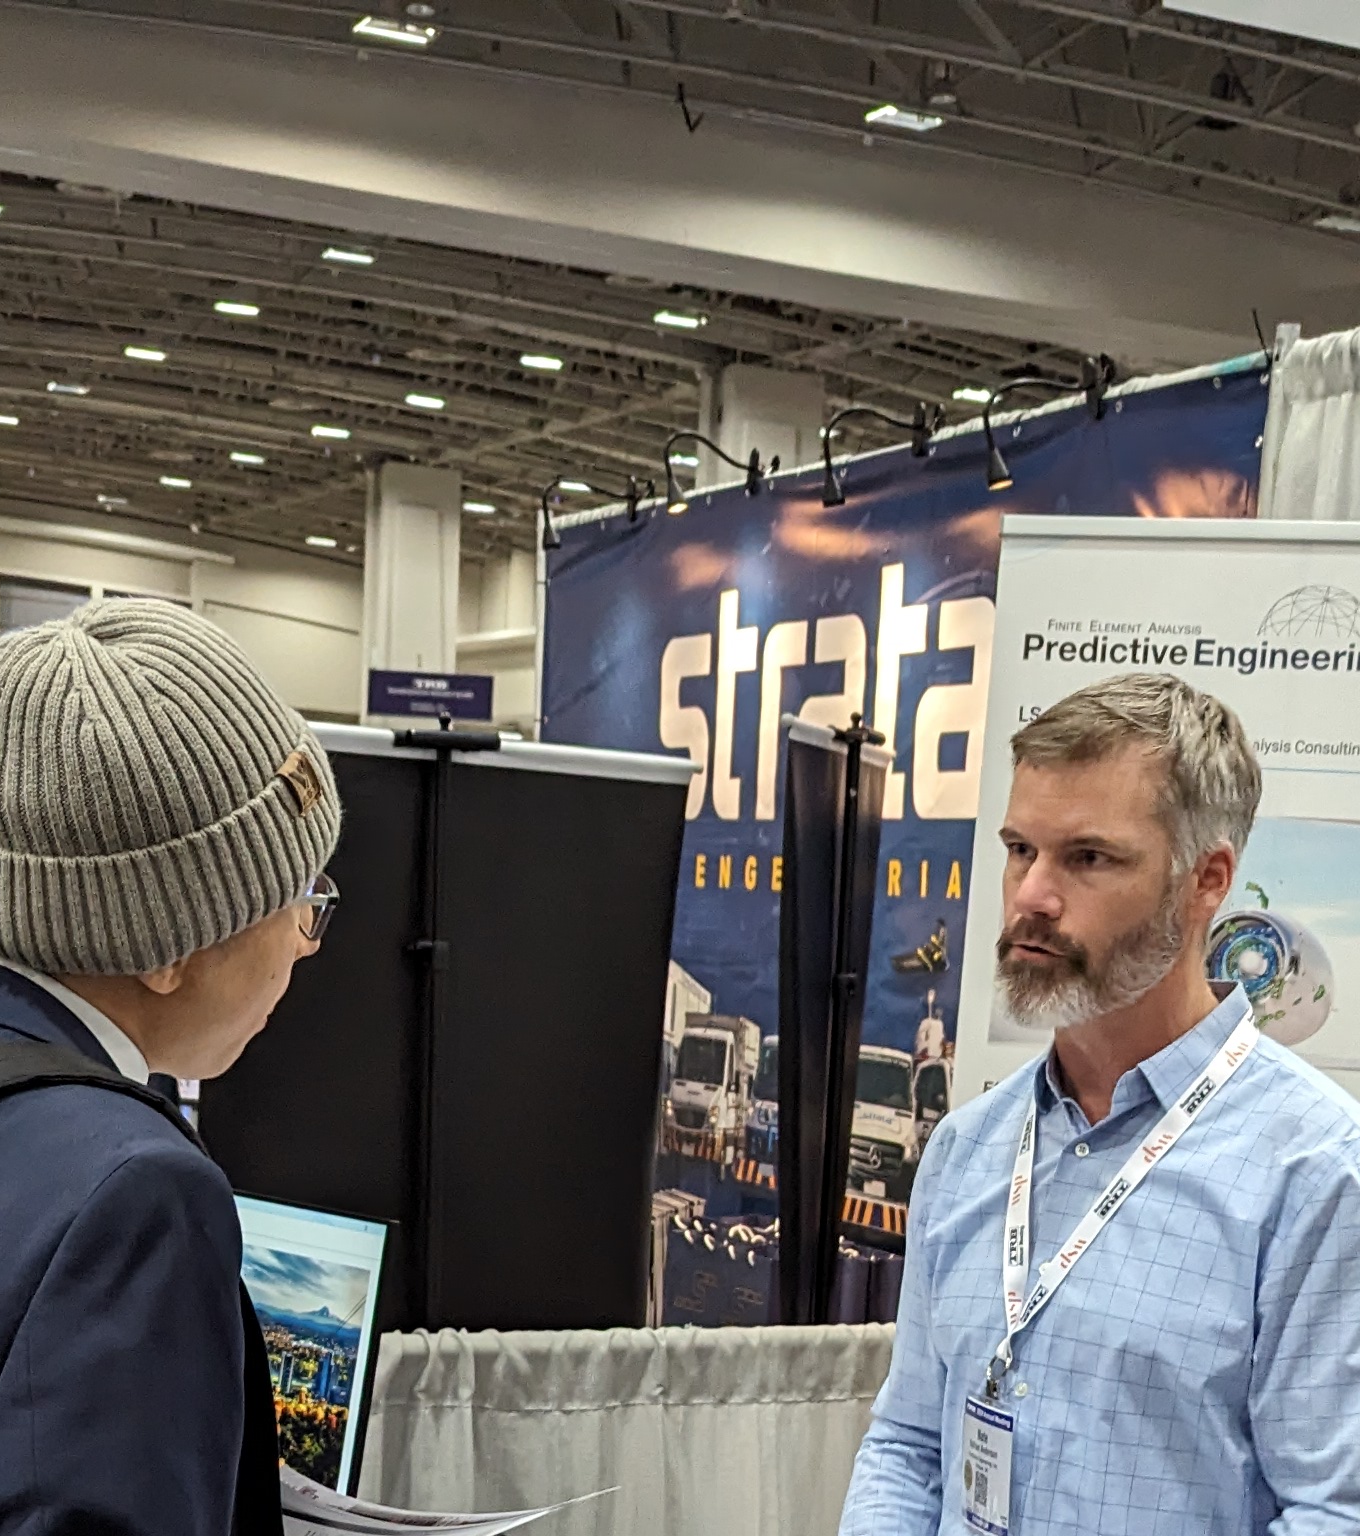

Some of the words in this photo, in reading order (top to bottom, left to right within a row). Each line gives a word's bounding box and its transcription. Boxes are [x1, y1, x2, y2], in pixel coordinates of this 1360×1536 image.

[1048, 618, 1082, 633] FINITE
[1089, 620, 1141, 634] ELEMENT
[1147, 621, 1202, 635] ANALYSIS
[1023, 633, 1189, 666] Predictive
[660, 562, 996, 821] strata
